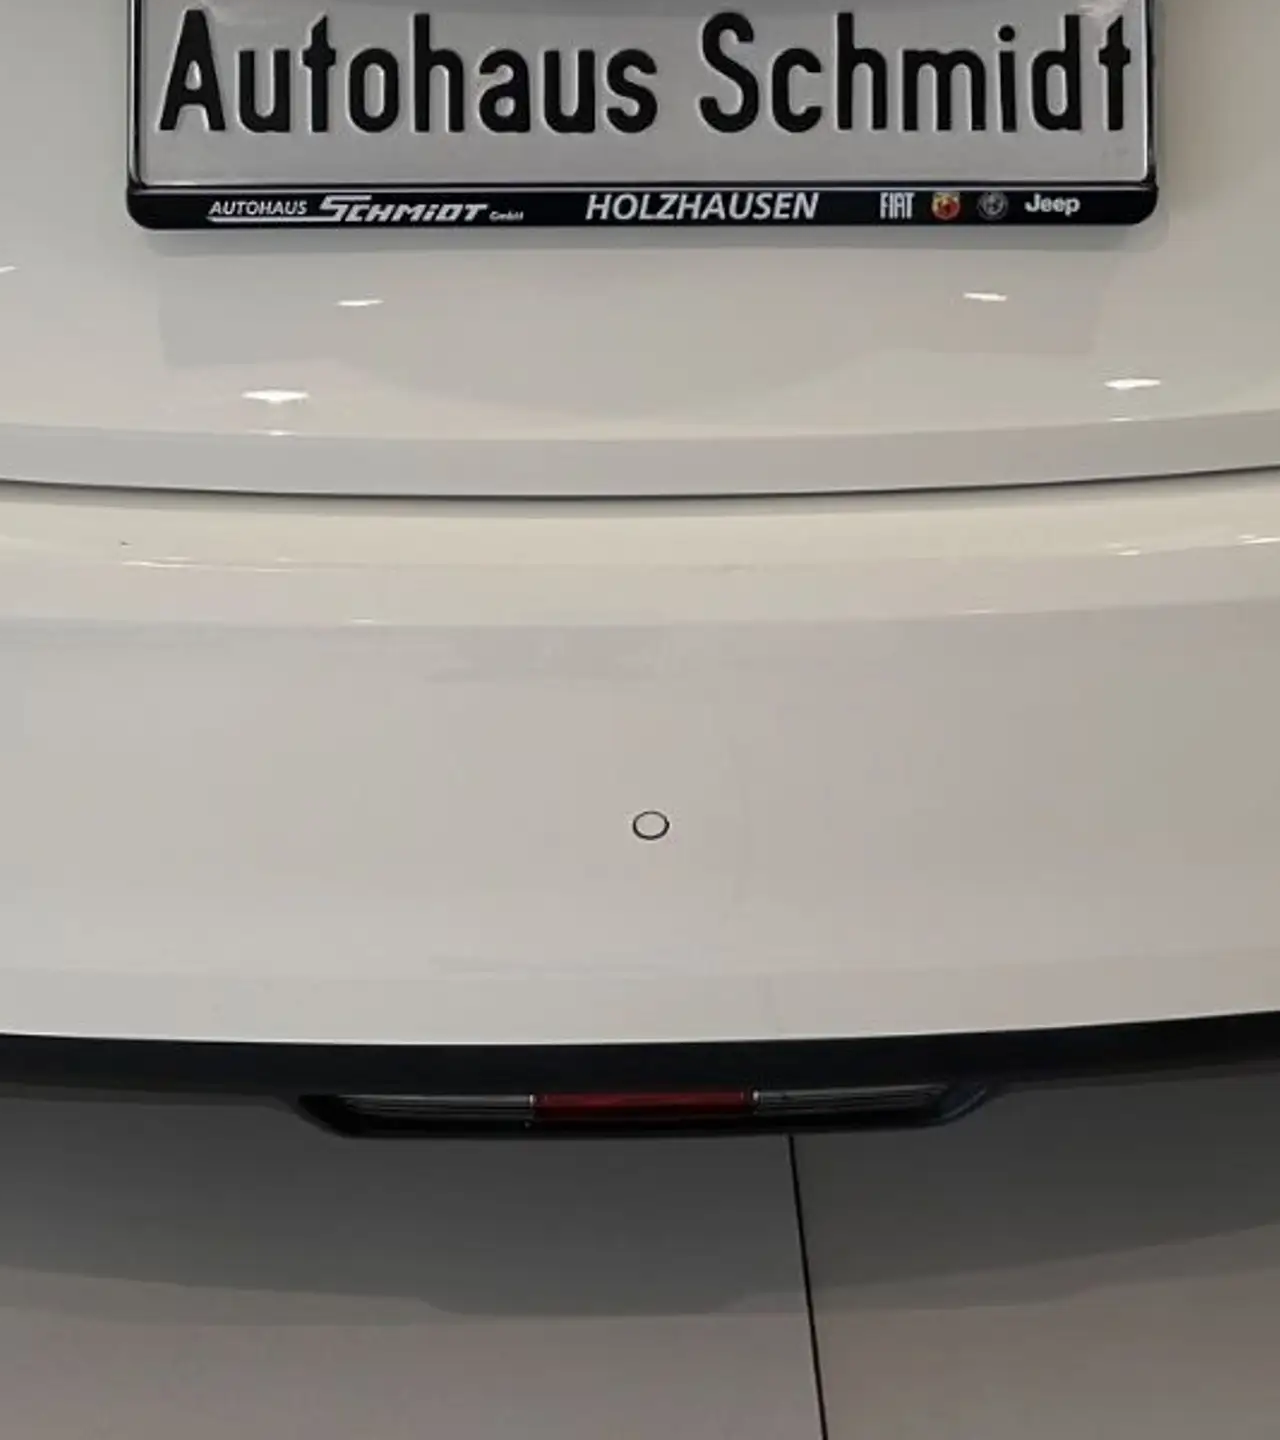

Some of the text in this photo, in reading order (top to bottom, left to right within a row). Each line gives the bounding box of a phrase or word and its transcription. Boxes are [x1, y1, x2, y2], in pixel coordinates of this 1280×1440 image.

[158, 8, 1130, 134] Autohaus Schmidt
[208, 200, 308, 216] AUTOHAUS
[585, 192, 819, 221] HOLZHAUSEN
[879, 192, 914, 220] FIAT
[1024, 192, 1081, 217] Jeep
